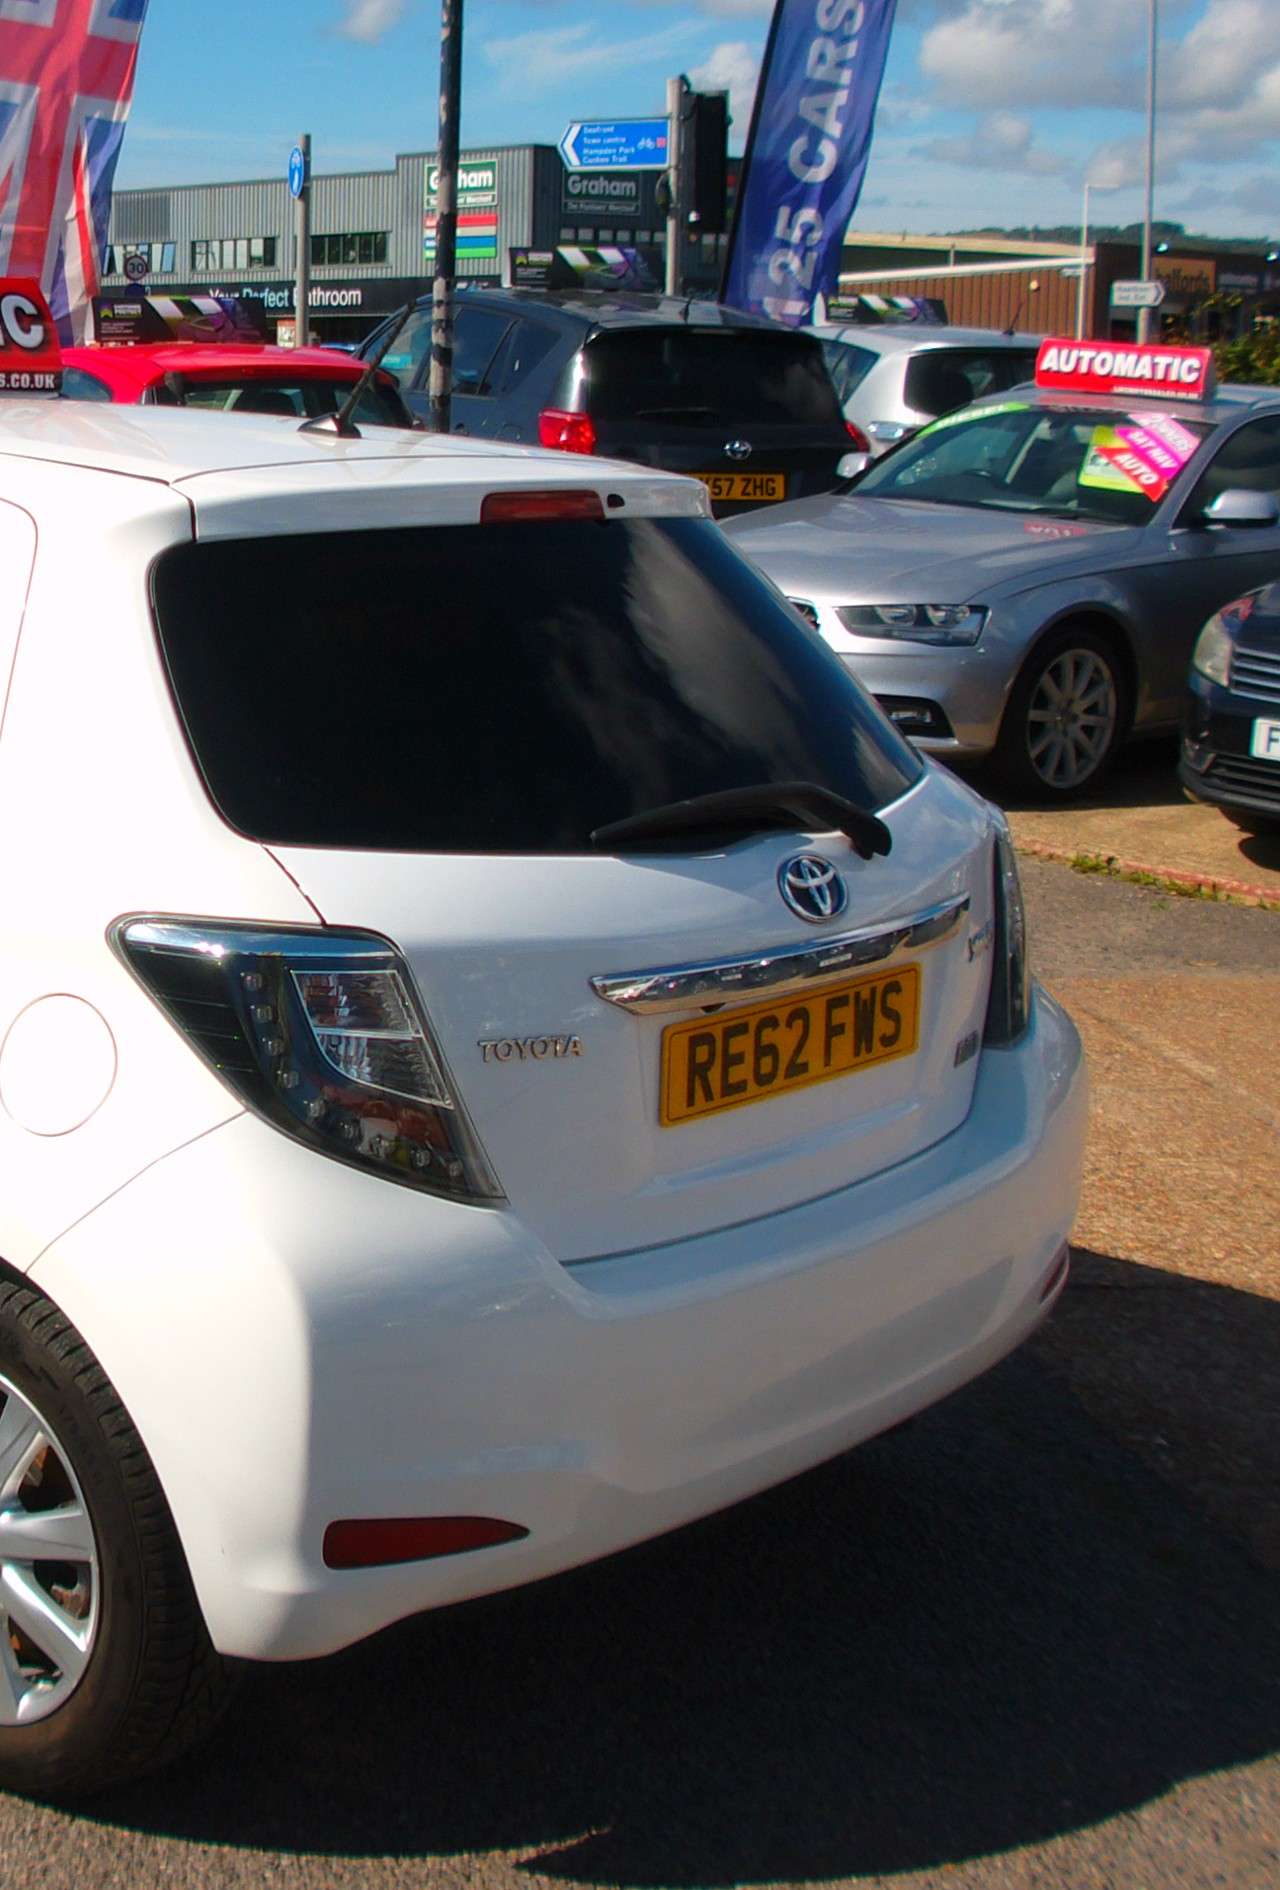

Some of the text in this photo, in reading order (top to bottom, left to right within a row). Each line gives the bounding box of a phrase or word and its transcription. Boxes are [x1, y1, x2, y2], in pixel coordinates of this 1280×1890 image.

[788, 0, 864, 183] CARS
[429, 169, 493, 190] Gham
[567, 174, 636, 197] Graham
[129, 262, 144, 274] 30
[1040, 347, 1202, 384] AUTOMATIC
[1113, 453, 1160, 484] AUTO
[740, 478, 776, 497] ZHG
[477, 1034, 584, 1063] TOYOTA
[686, 980, 902, 1108] RE62 FWS
